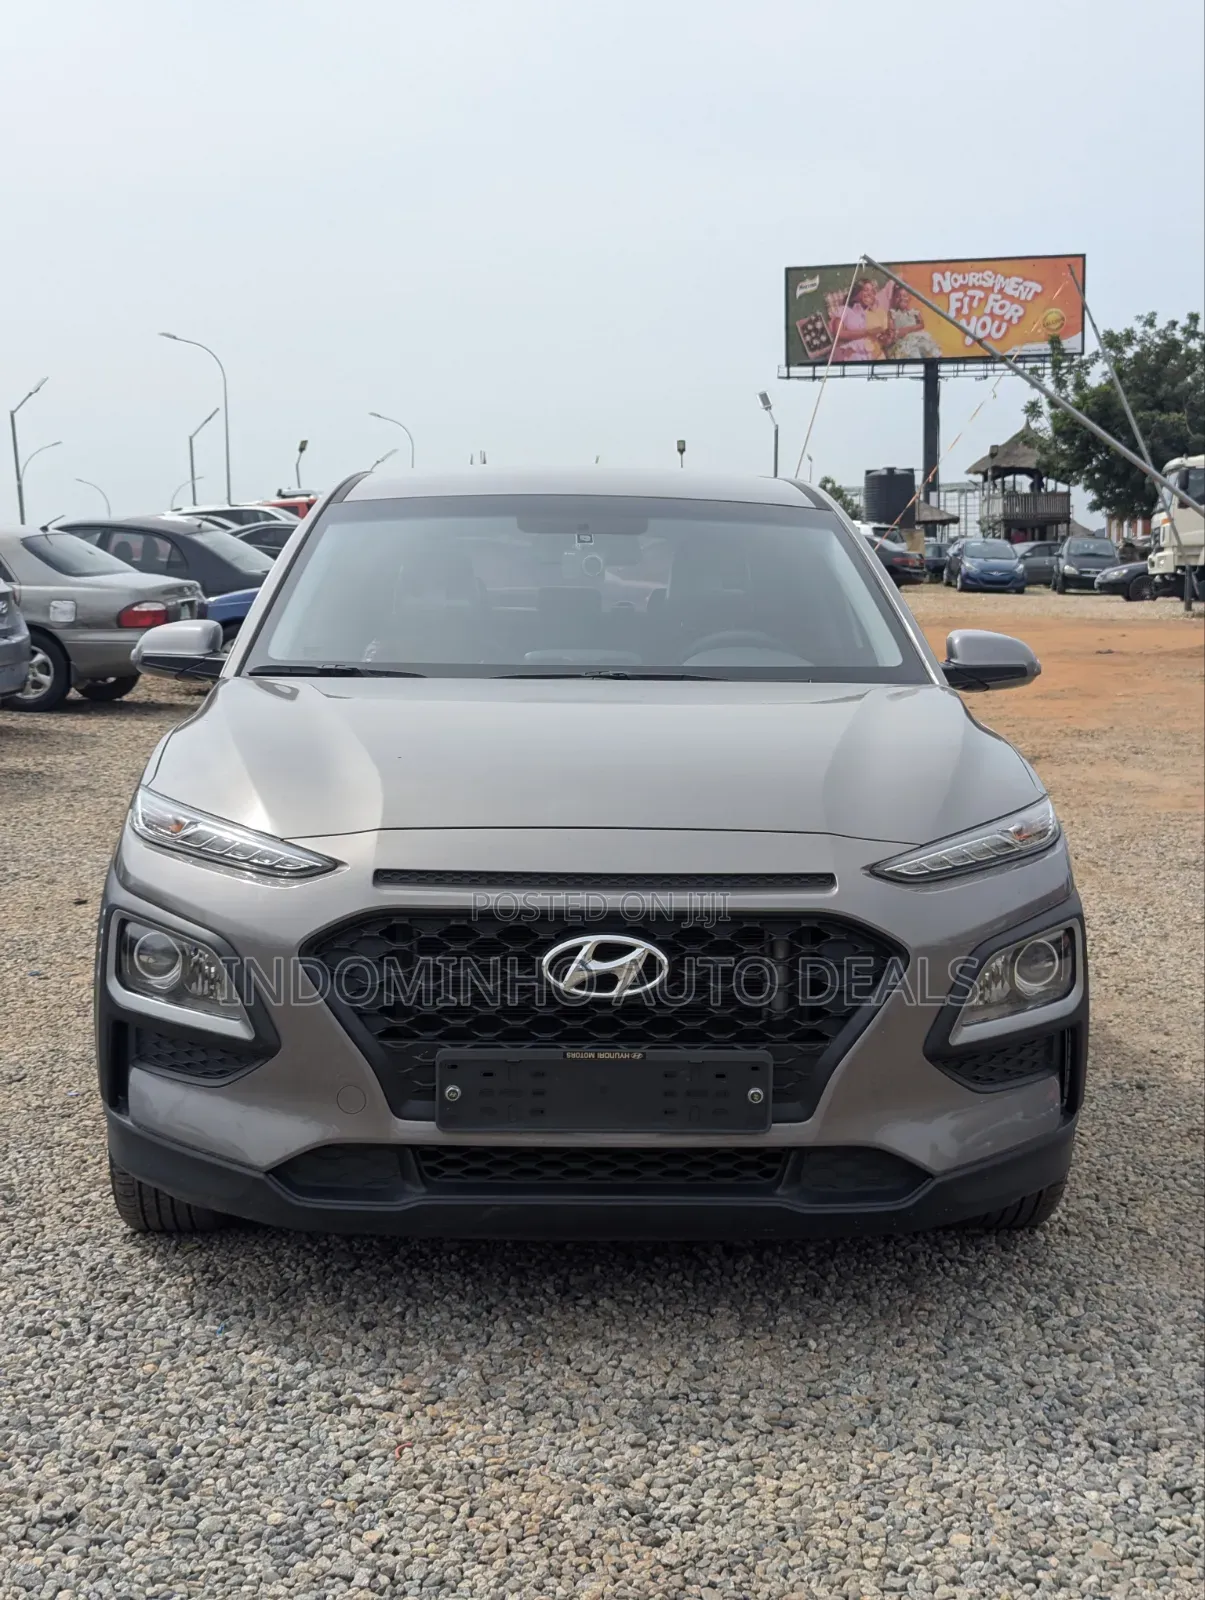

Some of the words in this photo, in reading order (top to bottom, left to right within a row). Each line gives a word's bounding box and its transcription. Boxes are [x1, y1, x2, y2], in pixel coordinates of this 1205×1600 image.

[932, 270, 1043, 301] NOURISHMENT
[984, 293, 1025, 325] FOR
[960, 315, 1008, 346] YOU
